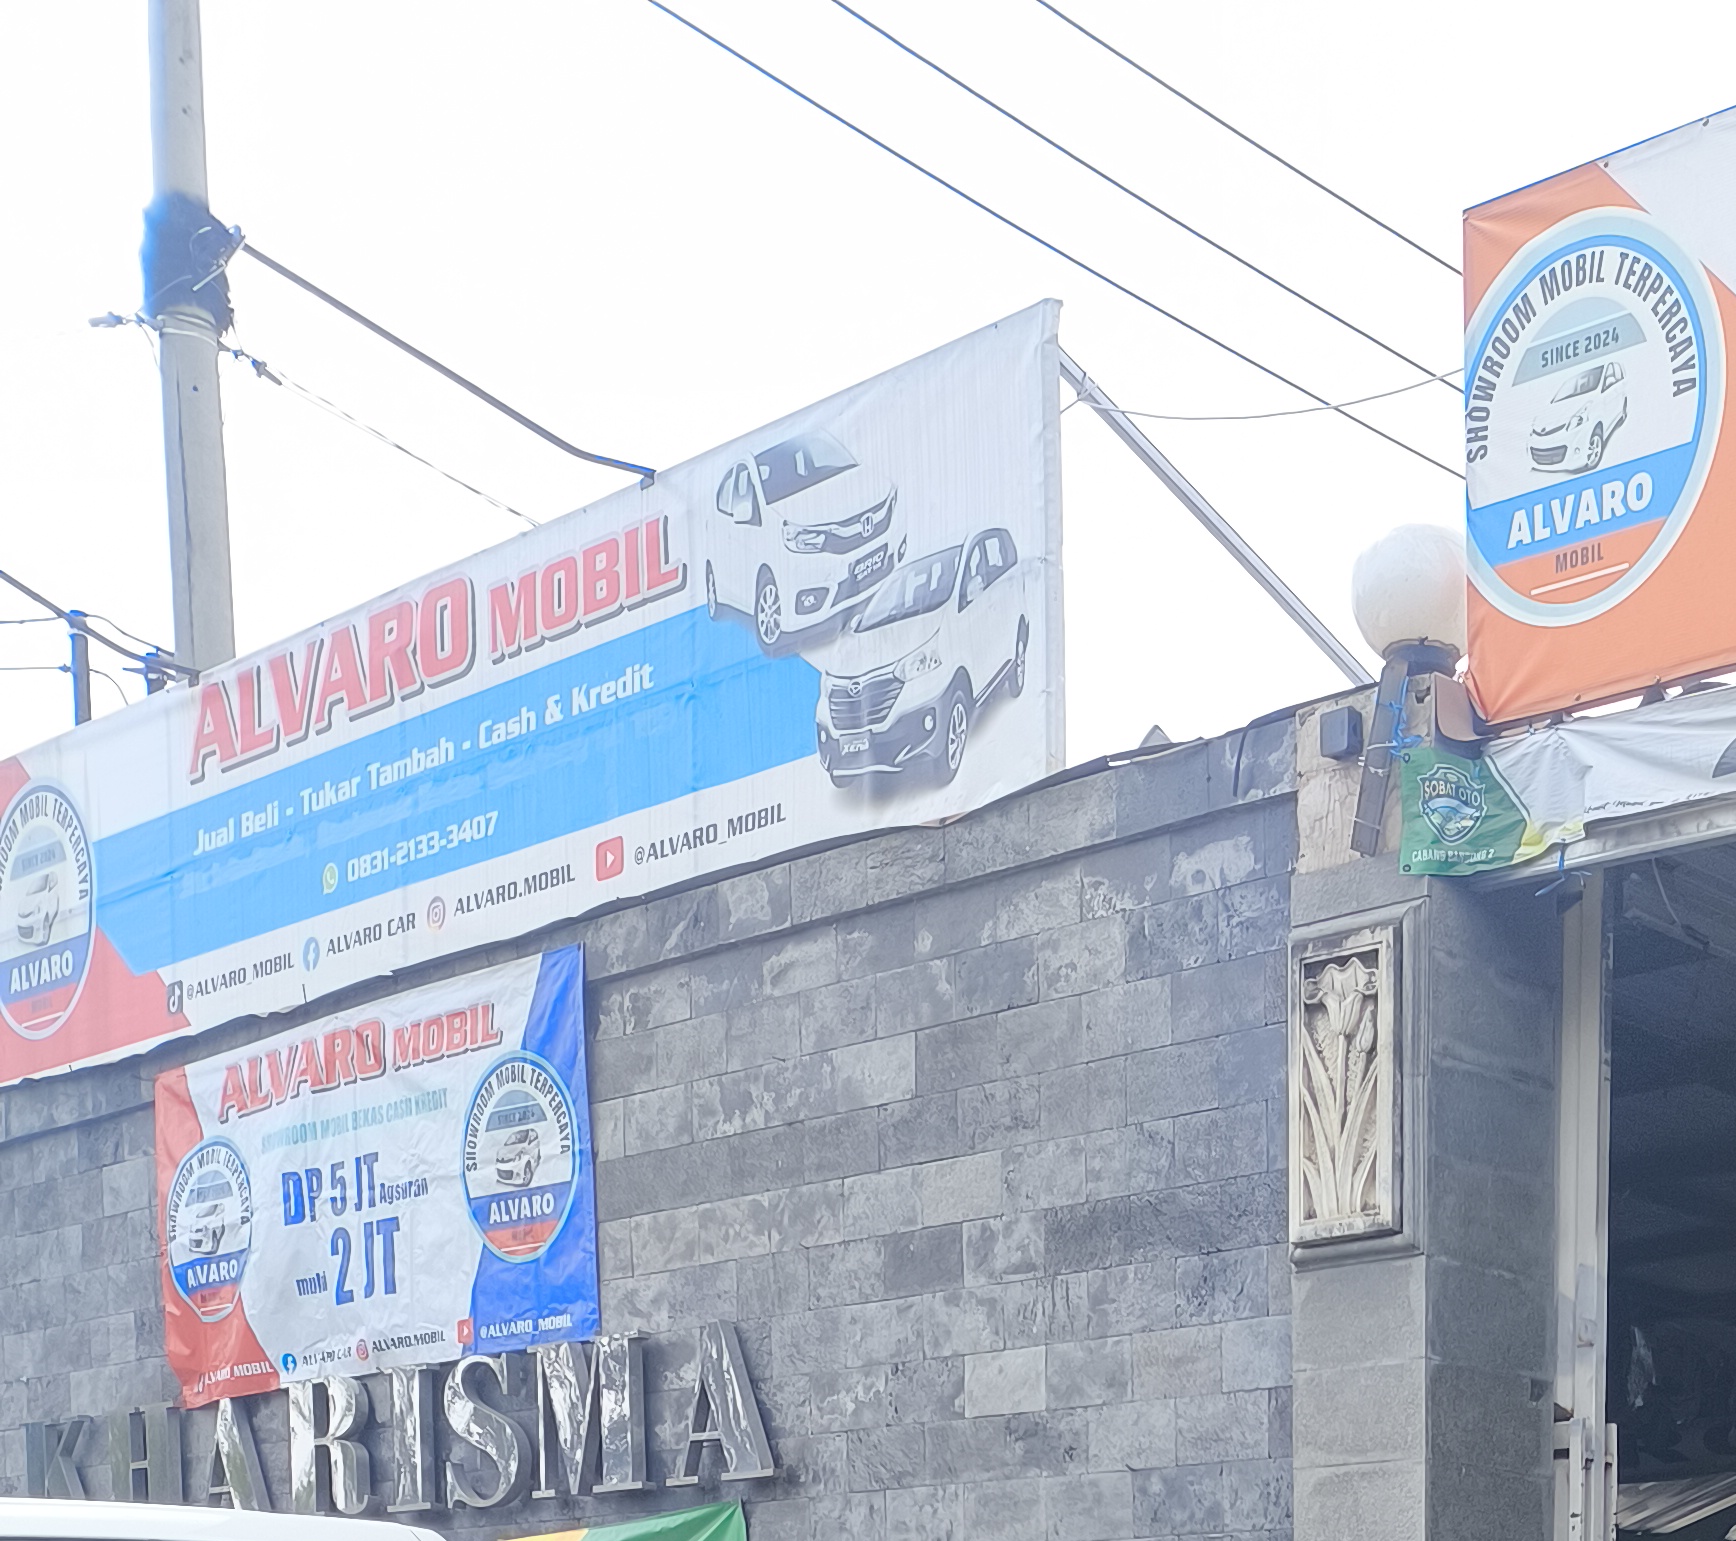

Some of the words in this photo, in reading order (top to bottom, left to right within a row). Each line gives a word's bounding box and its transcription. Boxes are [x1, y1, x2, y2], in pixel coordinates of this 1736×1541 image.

[1466, 292, 1537, 464] SHOWROOM
[1538, 249, 1605, 307] MOBIL
[1613, 251, 1698, 399] TERPERCAYA
[1540, 339, 1580, 369] SINCE
[1584, 326, 1621, 355] 2024
[1506, 470, 1654, 550] ALVARO
[1554, 542, 1605, 574] MOBIL
[188, 575, 477, 786] ALVARO
[488, 514, 688, 666] MOBIL
[193, 823, 235, 857] Jual
[240, 801, 279, 840] Beli
[300, 774, 361, 818] Tukar
[367, 737, 455, 791] Tambah
[478, 705, 537, 752] Cash
[543, 693, 563, 727] &
[571, 661, 655, 718] Kredit
[1424, 780, 1456, 801] SOBAT
[1458, 788, 1481, 806] OTO
[19, 793, 49, 830] MOBIL
[346, 809, 500, 884] 0831-2133-3407
[185, 951, 296, 1001] @ALVARO_MOBIL
[326, 918, 383, 959] ALVARO
[387, 911, 417, 944] CAR
[453, 863, 577, 918] ALVARO.MOBIL
[633, 801, 788, 867] @ALVARO_MOBIL
[9, 949, 74, 994] ALVARO
[217, 1018, 386, 1124] ALVARO
[391, 1001, 504, 1072] MOBIL
[496, 1063, 527, 1090] MOBIL
[320, 1110, 350, 1141] MOBIL
[351, 1102, 385, 1131] BEKAS
[385, 1093, 413, 1123] CASH
[281, 1167, 323, 1226] DP
[330, 1160, 347, 1217] 5
[354, 1151, 379, 1212] JT
[488, 1192, 555, 1225] ALVARO
[330, 1226, 355, 1306] 2
[363, 1216, 401, 1299] JT
[20, 1320, 776, 1514] KHARISMA
